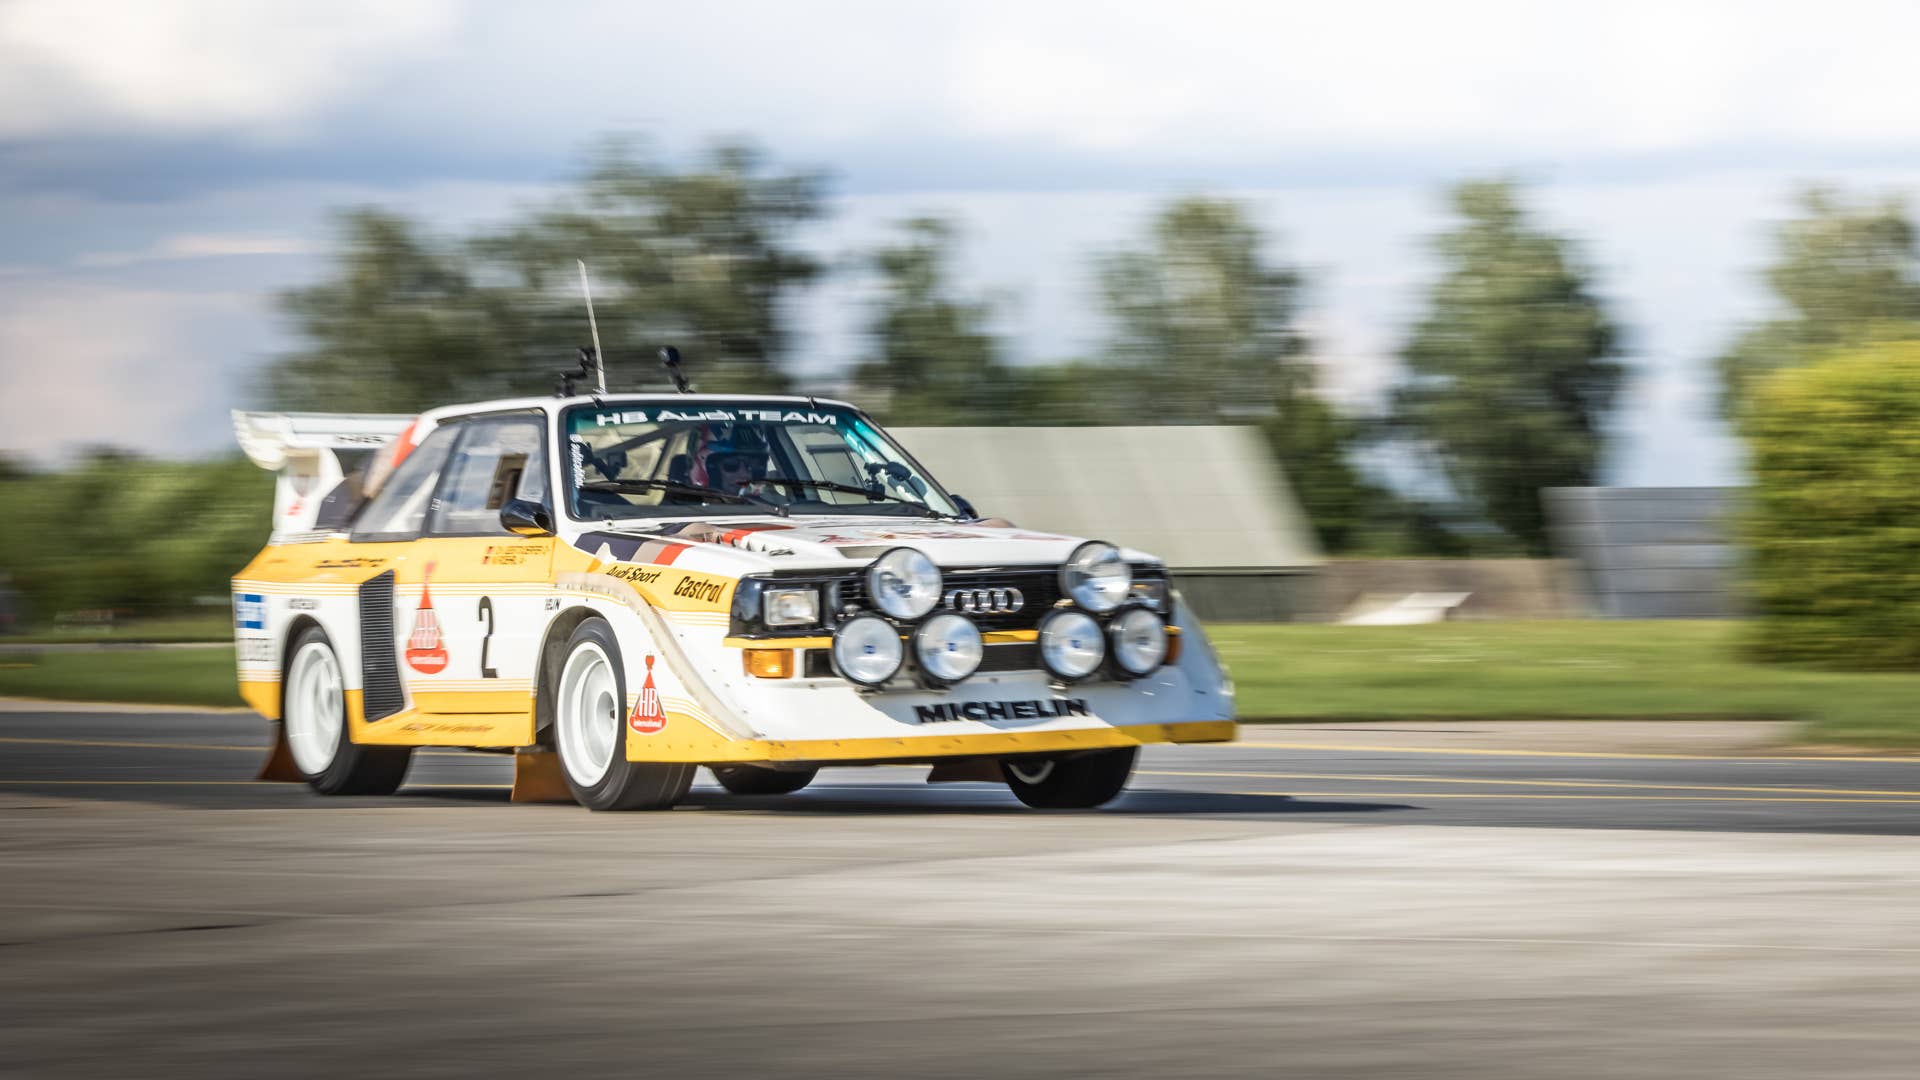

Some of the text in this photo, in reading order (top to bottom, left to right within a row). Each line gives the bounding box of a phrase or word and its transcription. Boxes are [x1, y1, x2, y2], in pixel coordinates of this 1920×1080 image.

[596, 411, 648, 426] HB
[738, 409, 837, 425] TEAM
[627, 567, 661, 584] Sport
[673, 575, 727, 604] Castrol
[479, 595, 498, 678] 2
[638, 687, 658, 717] HB
[912, 699, 1090, 724] MICHELIN
